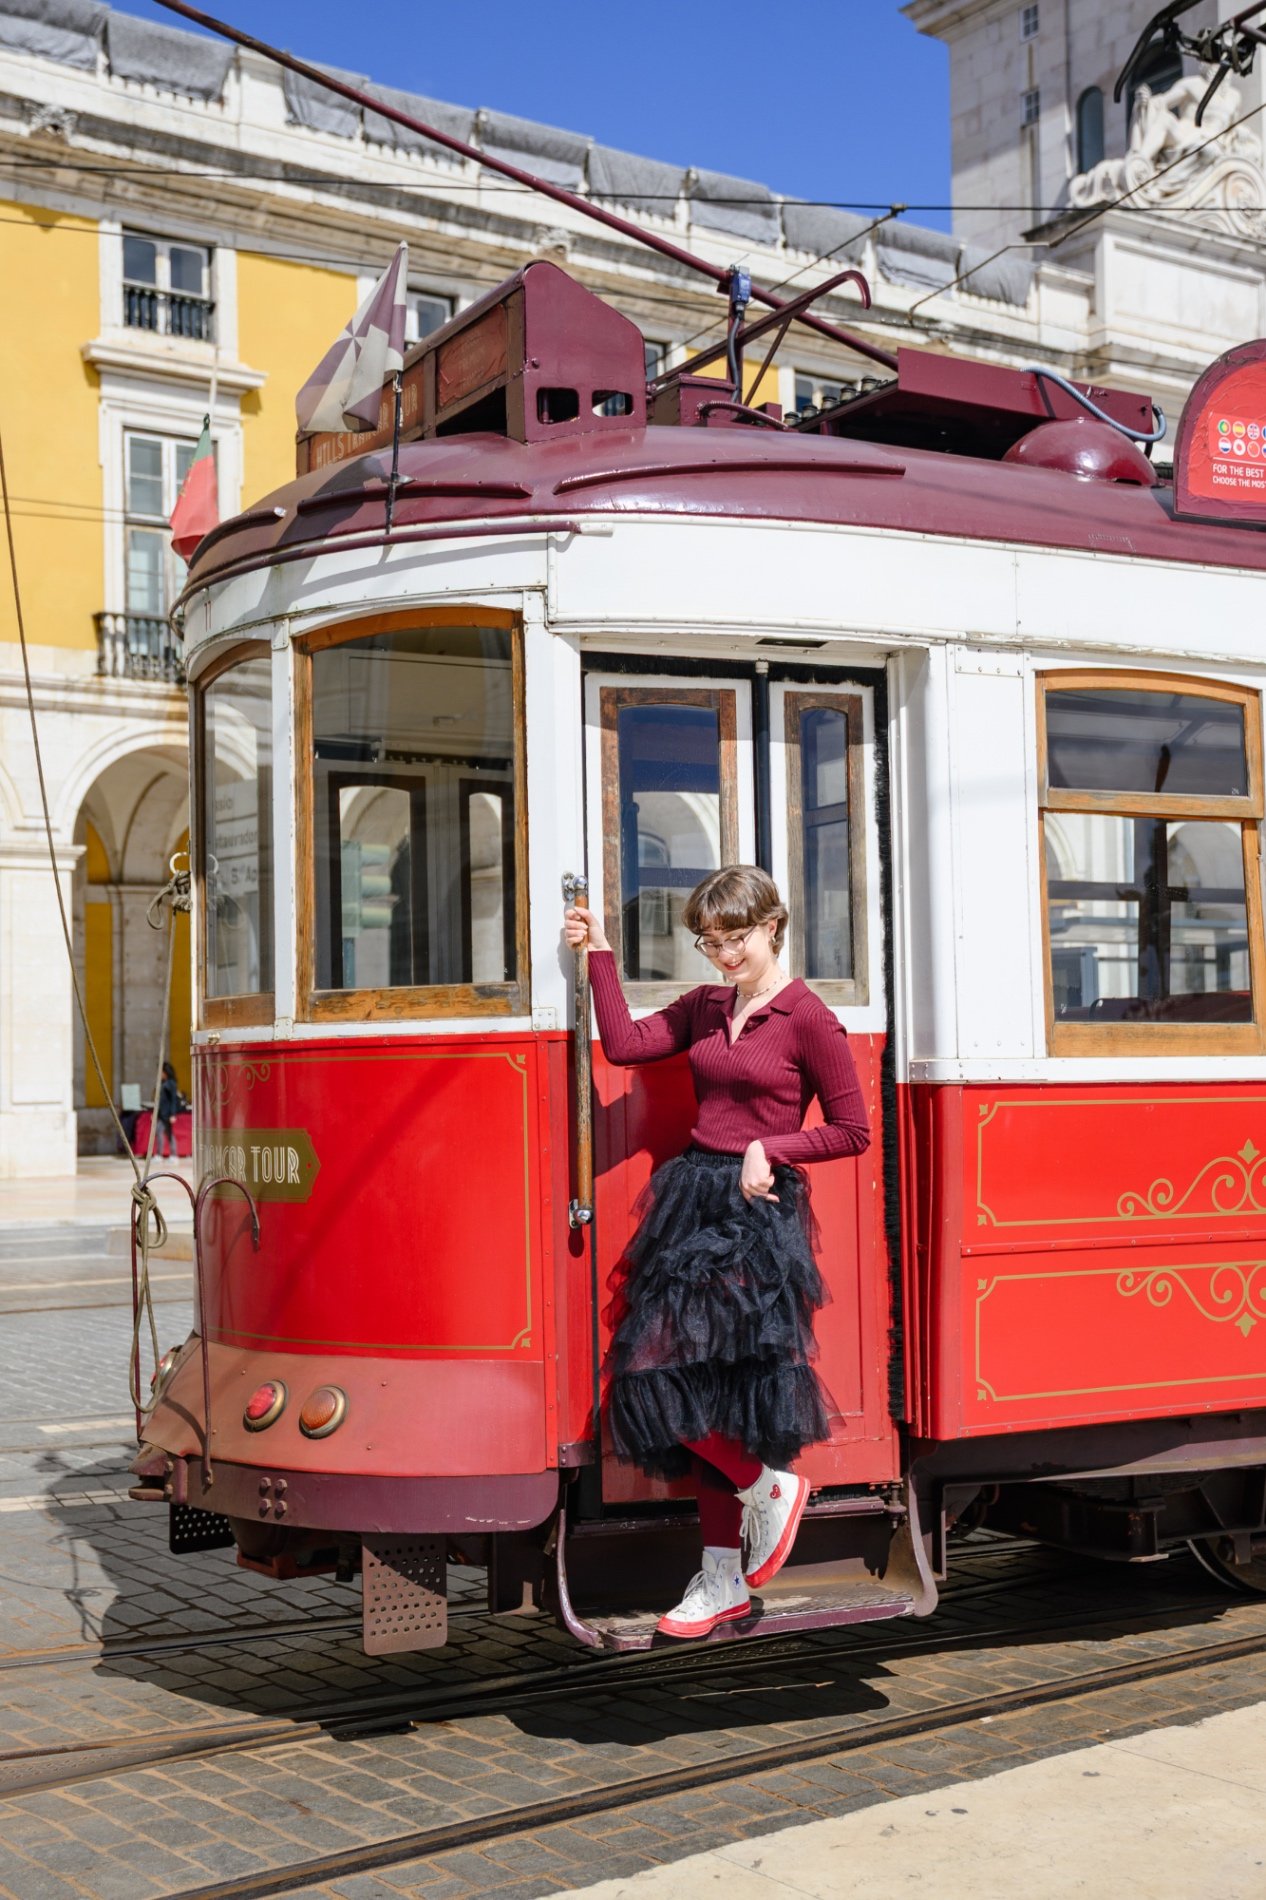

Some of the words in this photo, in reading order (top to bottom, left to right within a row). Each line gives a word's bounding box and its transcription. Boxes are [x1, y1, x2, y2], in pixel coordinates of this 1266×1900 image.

[391, 383, 418, 426] TUR
[1212, 463, 1228, 474] FOR
[1229, 465, 1244, 476] THE
[1245, 467, 1265, 478] BEST
[1212, 475, 1237, 486] CHOOSE
[1238, 478, 1251, 488] THE
[250, 1145, 300, 1184] TOUR
